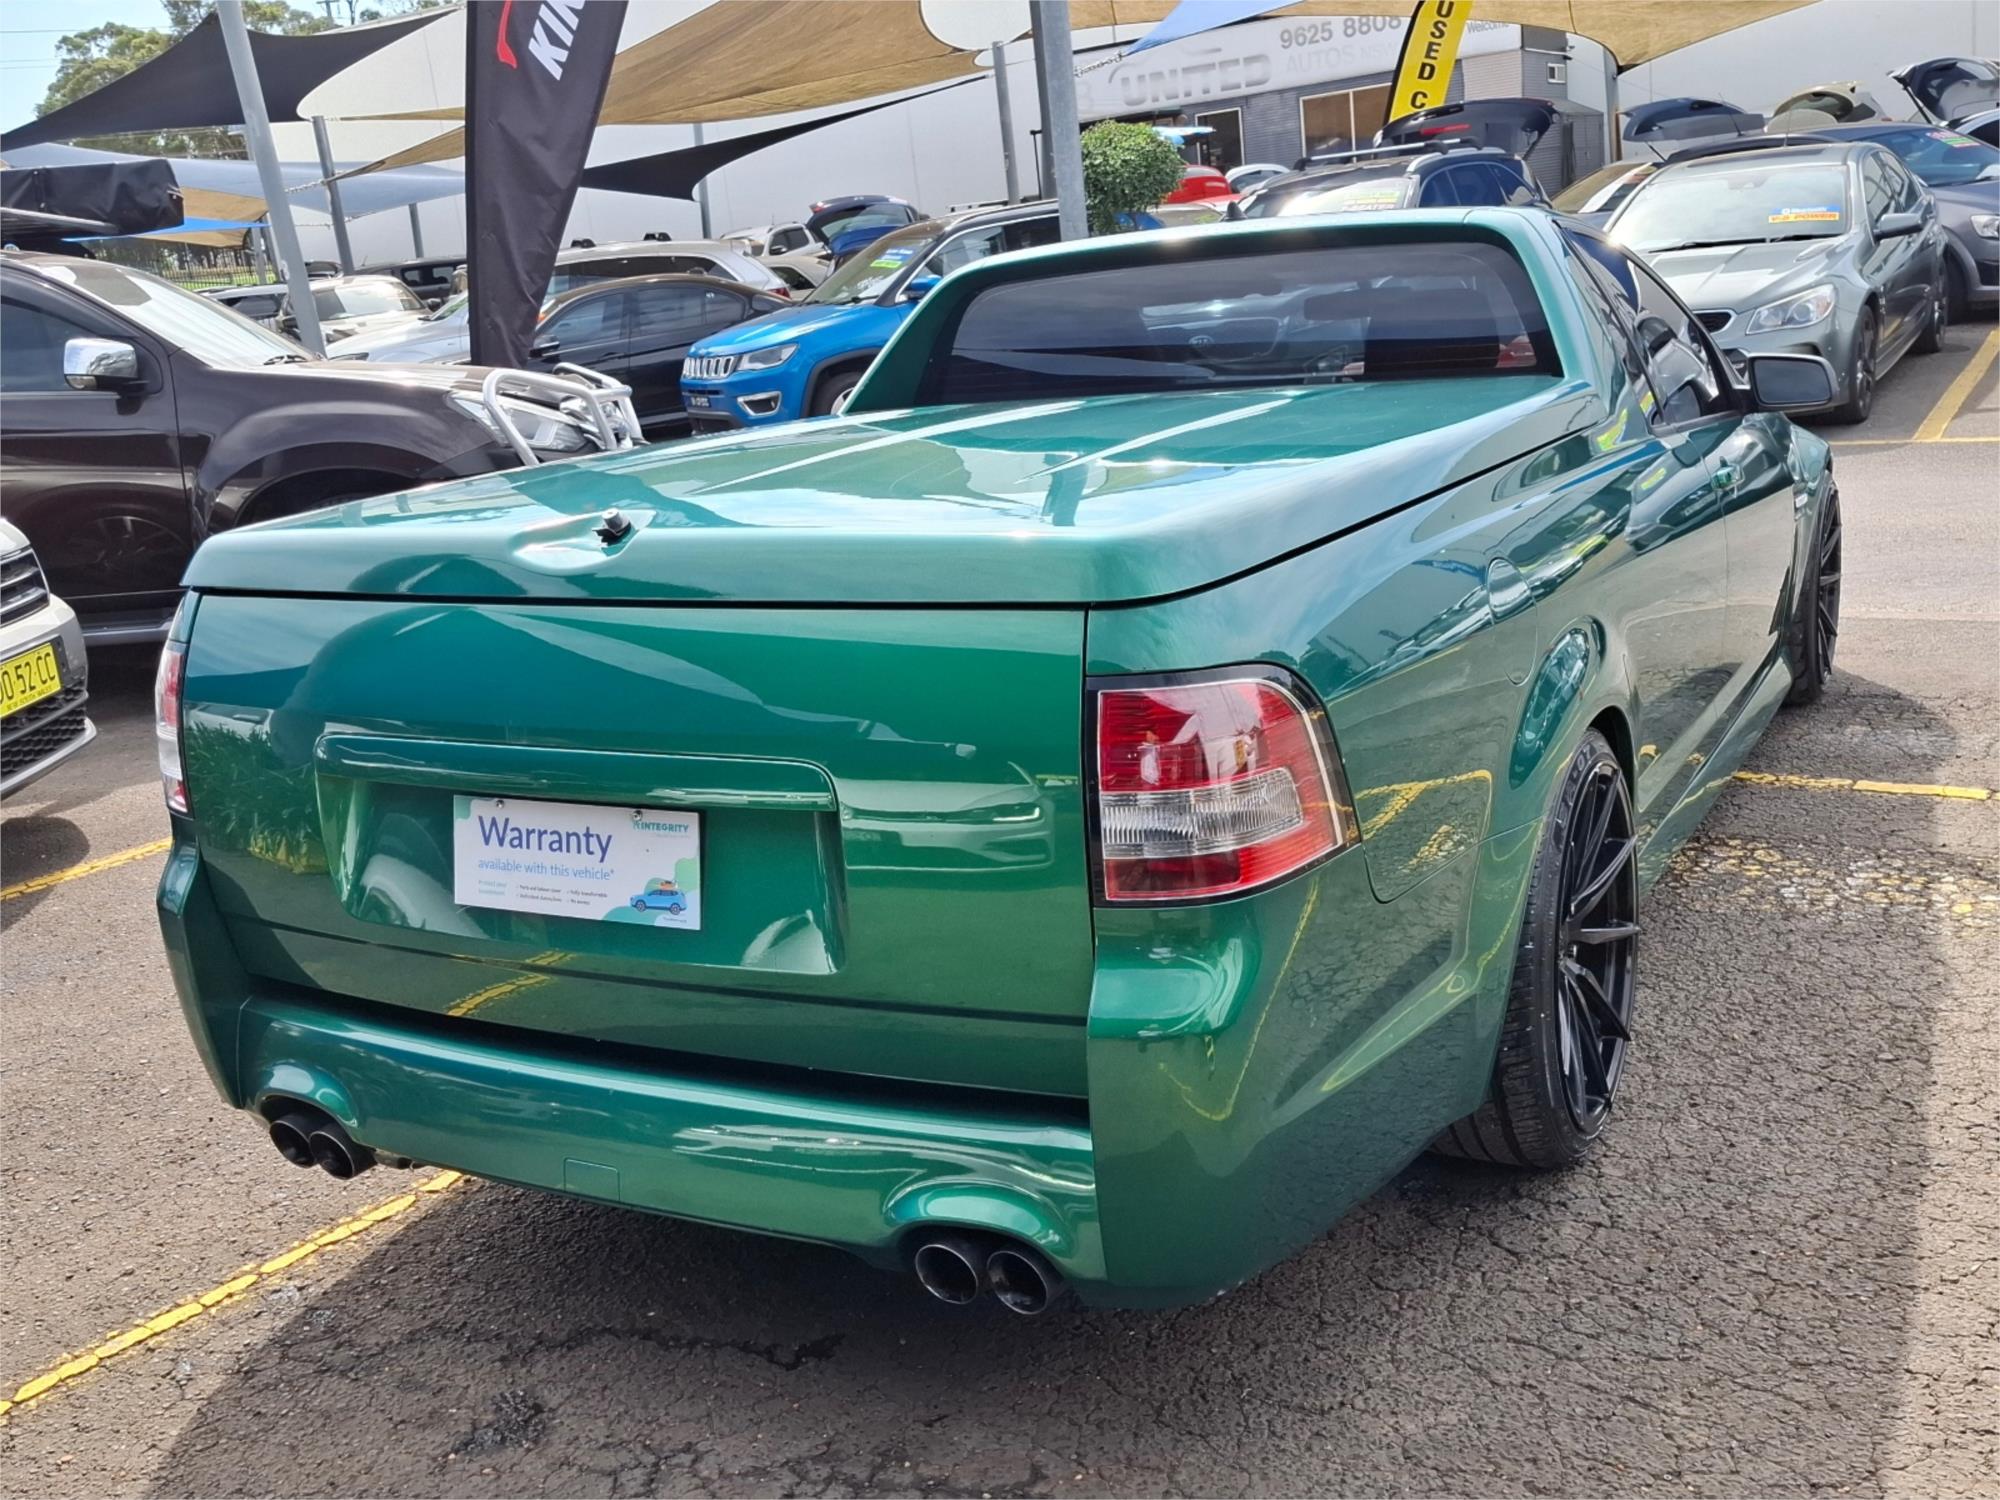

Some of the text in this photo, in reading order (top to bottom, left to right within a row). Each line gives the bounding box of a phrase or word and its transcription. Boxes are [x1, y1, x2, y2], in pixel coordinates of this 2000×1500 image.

[1279, 15, 1402, 50] 9625 8808
[1417, 0, 1455, 81] USED
[1286, 44, 1356, 75] AUTOS
[1121, 53, 1271, 107] UNITED
[478, 815, 613, 863] Warranty
[640, 821, 690, 833] INTEGRITY
[477, 857, 522, 873] available
[523, 861, 547, 876] with
[549, 863, 570, 878] this
